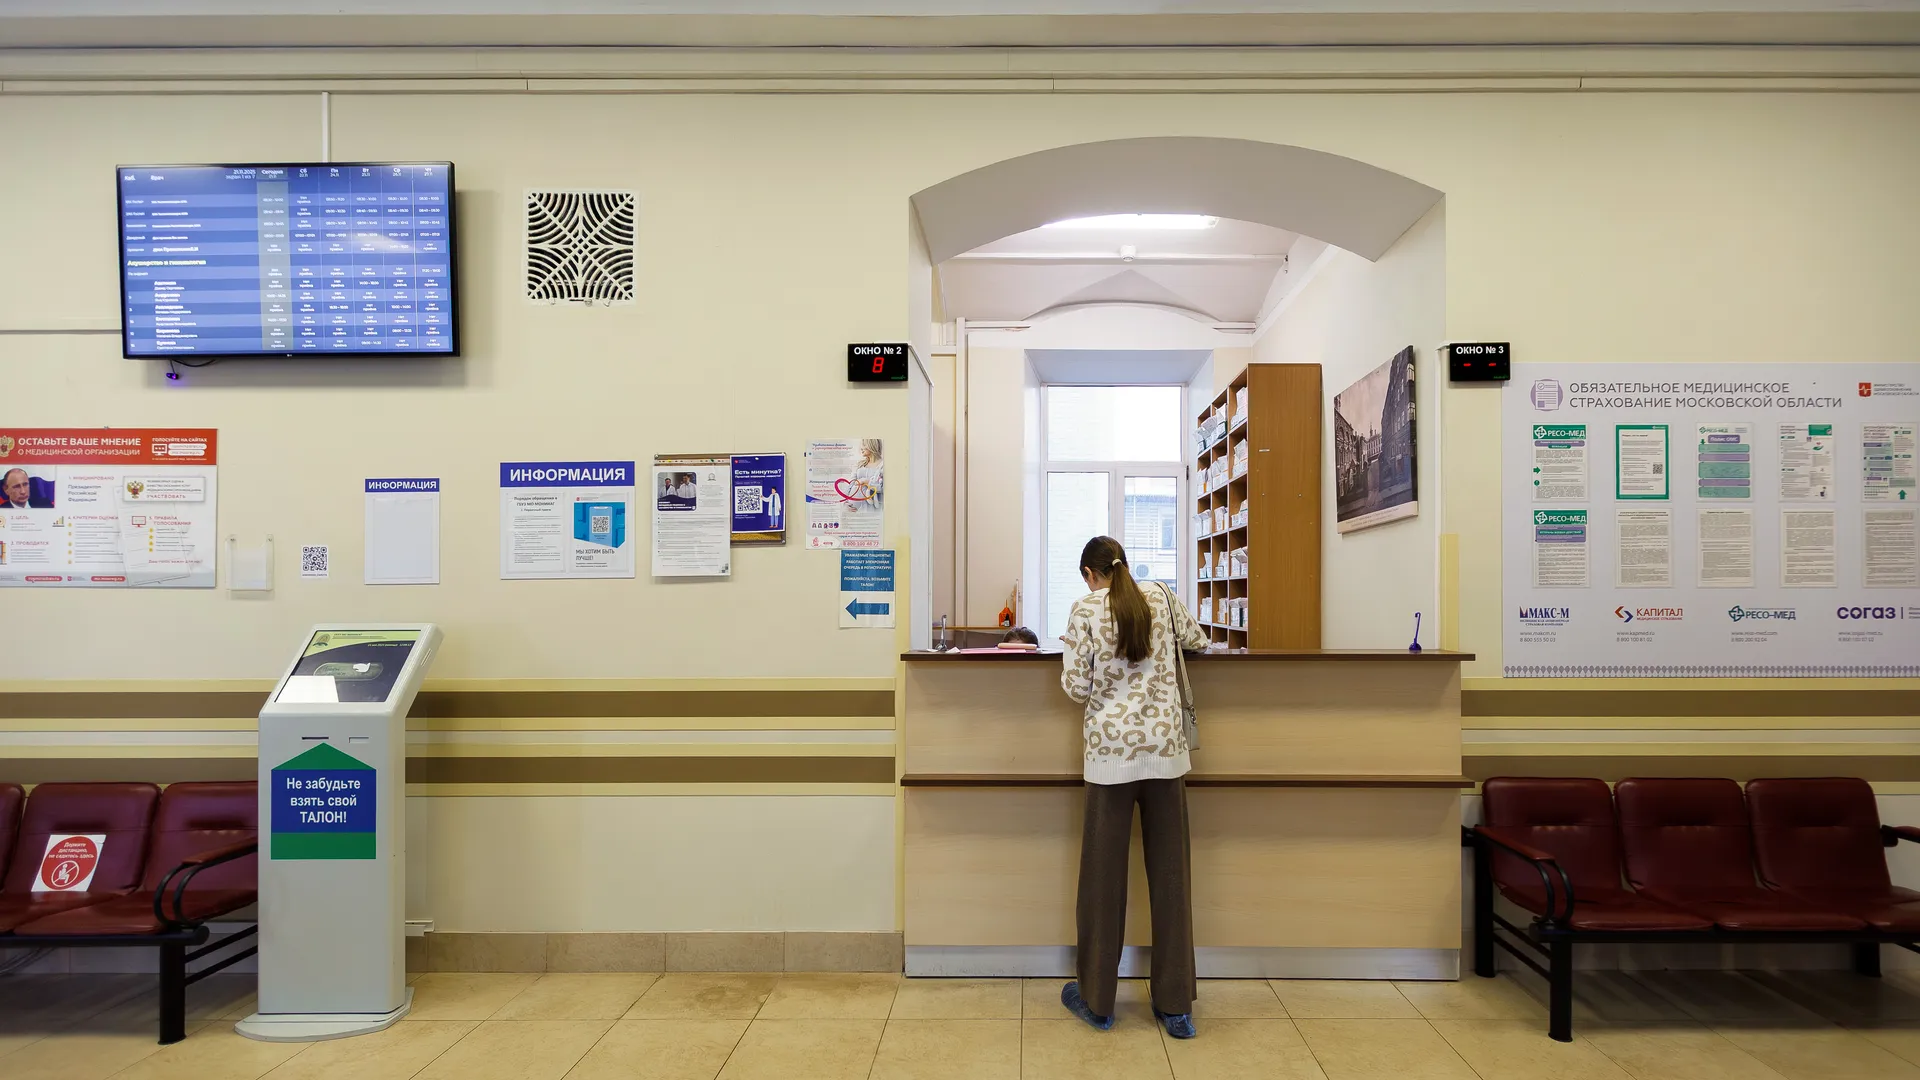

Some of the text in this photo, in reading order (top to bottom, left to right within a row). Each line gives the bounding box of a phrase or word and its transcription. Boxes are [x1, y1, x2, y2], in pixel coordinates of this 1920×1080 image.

[854, 346, 902, 355] ОКНО № 2
[1456, 345, 1504, 355] ОКНО № 3
[872, 357, 885, 373] 8
[1569, 383, 1790, 395] ОБЯЗАТЕЛЬНОЕ МЕДИЦИНСКОЕ
[1569, 395, 1842, 408] СТРАХОВАНИЕ МОСКОВСКОЙ ОБЛАСТИ
[1547, 430, 1586, 438] РЕСО-МЕД
[18, 438, 141, 446] ОСТАВЬТЕ ВАШЕ МНЕНИЕ
[25, 447, 83, 456] МЕДИЦИНСКОЙ
[84, 448, 141, 456] ОРГАНИЗАЦИИ
[510, 468, 626, 483] ИНФОРМАЦИЯ
[750, 468, 782, 476] минутка?
[368, 481, 437, 491] ИНФОРМАЦИЯ
[1548, 515, 1587, 523] РЕСО-МЕД
[1529, 607, 1570, 619] МАКС-М
[1636, 608, 1683, 617] КАПИТАЛ
[1745, 611, 1796, 620] РЕСО-МЕД
[286, 777, 361, 791] Не забудьте
[290, 795, 357, 807] взять свой
[300, 811, 347, 823] ТАЛОН!
